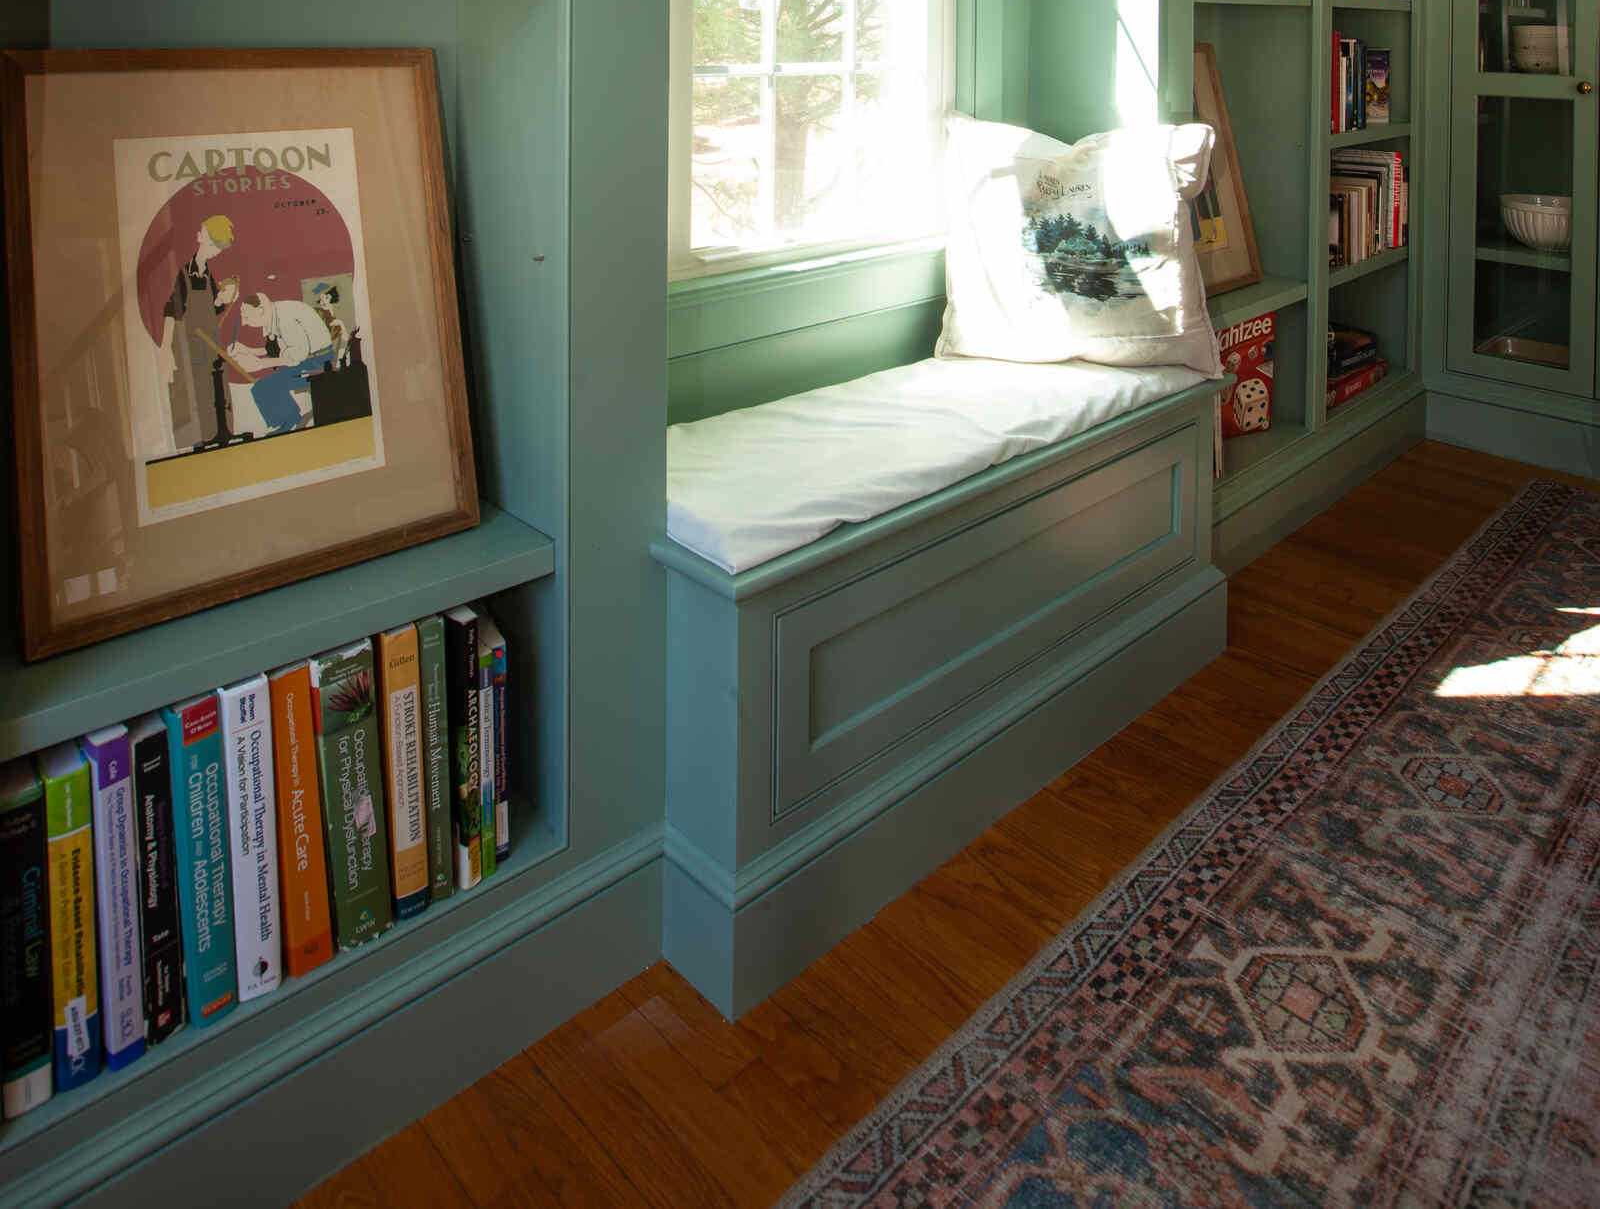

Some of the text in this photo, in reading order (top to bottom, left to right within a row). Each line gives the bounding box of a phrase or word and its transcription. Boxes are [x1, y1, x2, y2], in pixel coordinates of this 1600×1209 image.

[148, 143, 332, 183] CARTOON
[192, 174, 293, 197] STORIES
[286, 693, 298, 745] Occupational
[402, 691, 416, 740] STROKE
[467, 689, 479, 794] ARCHAEOLOGY
[108, 759, 118, 780] Cole
[290, 745, 301, 777] Therapy
[429, 702, 442, 810] Human Movement
[114, 787, 127, 814] Group
[187, 772, 205, 839] Children
[237, 736, 251, 856] A Vision for Participation
[291, 789, 306, 832] Acute
[337, 735, 361, 890] for Physical Dysfunction
[404, 742, 421, 842] REHABILITATION
[115, 815, 130, 857] Dynamics
[119, 859, 129, 869] in
[144, 794, 160, 909] Anatomy & Physiology
[205, 762, 227, 927] Occupational Therapy
[249, 730, 272, 942] Occupational Therapy in Mental Health
[294, 833, 310, 871] Care
[24, 866, 42, 979] Criminal Law
[119, 870, 132, 928] Occupational
[193, 859, 212, 953] Adolescents
[73, 931, 85, 996] Rehabilitatio
[122, 931, 134, 966] Therapy
